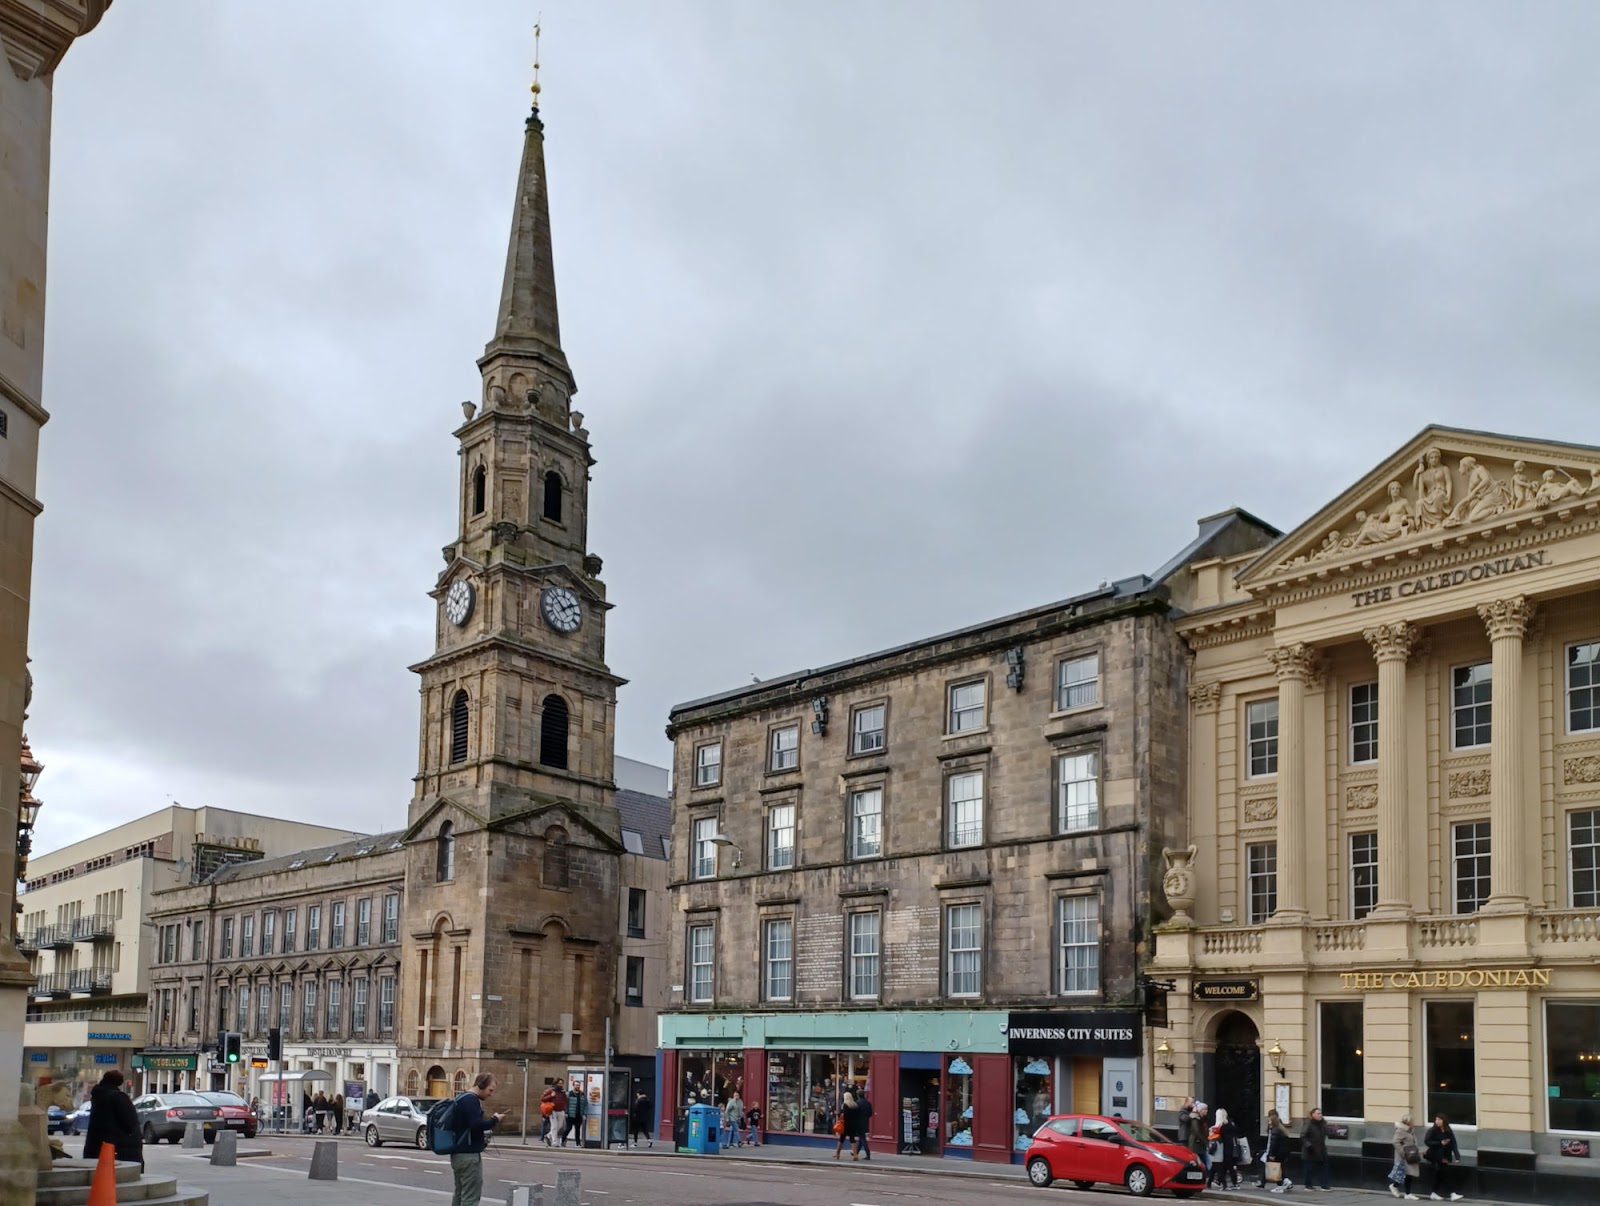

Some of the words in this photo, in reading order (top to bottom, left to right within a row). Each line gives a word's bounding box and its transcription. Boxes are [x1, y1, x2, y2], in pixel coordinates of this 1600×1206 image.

[1352, 586, 1392, 608] THE
[1398, 549, 1552, 598] CALEDONIAN
[1340, 972, 1385, 989] THE
[1390, 968, 1554, 988] CALEDONIAN
[1204, 986, 1246, 995] WELCOME
[88, 1032, 132, 1040] PRIMARK
[1009, 1028, 1065, 1040] INVERNESS
[1067, 1028, 1092, 1040] CITY
[1094, 1028, 1133, 1040] SUITES
